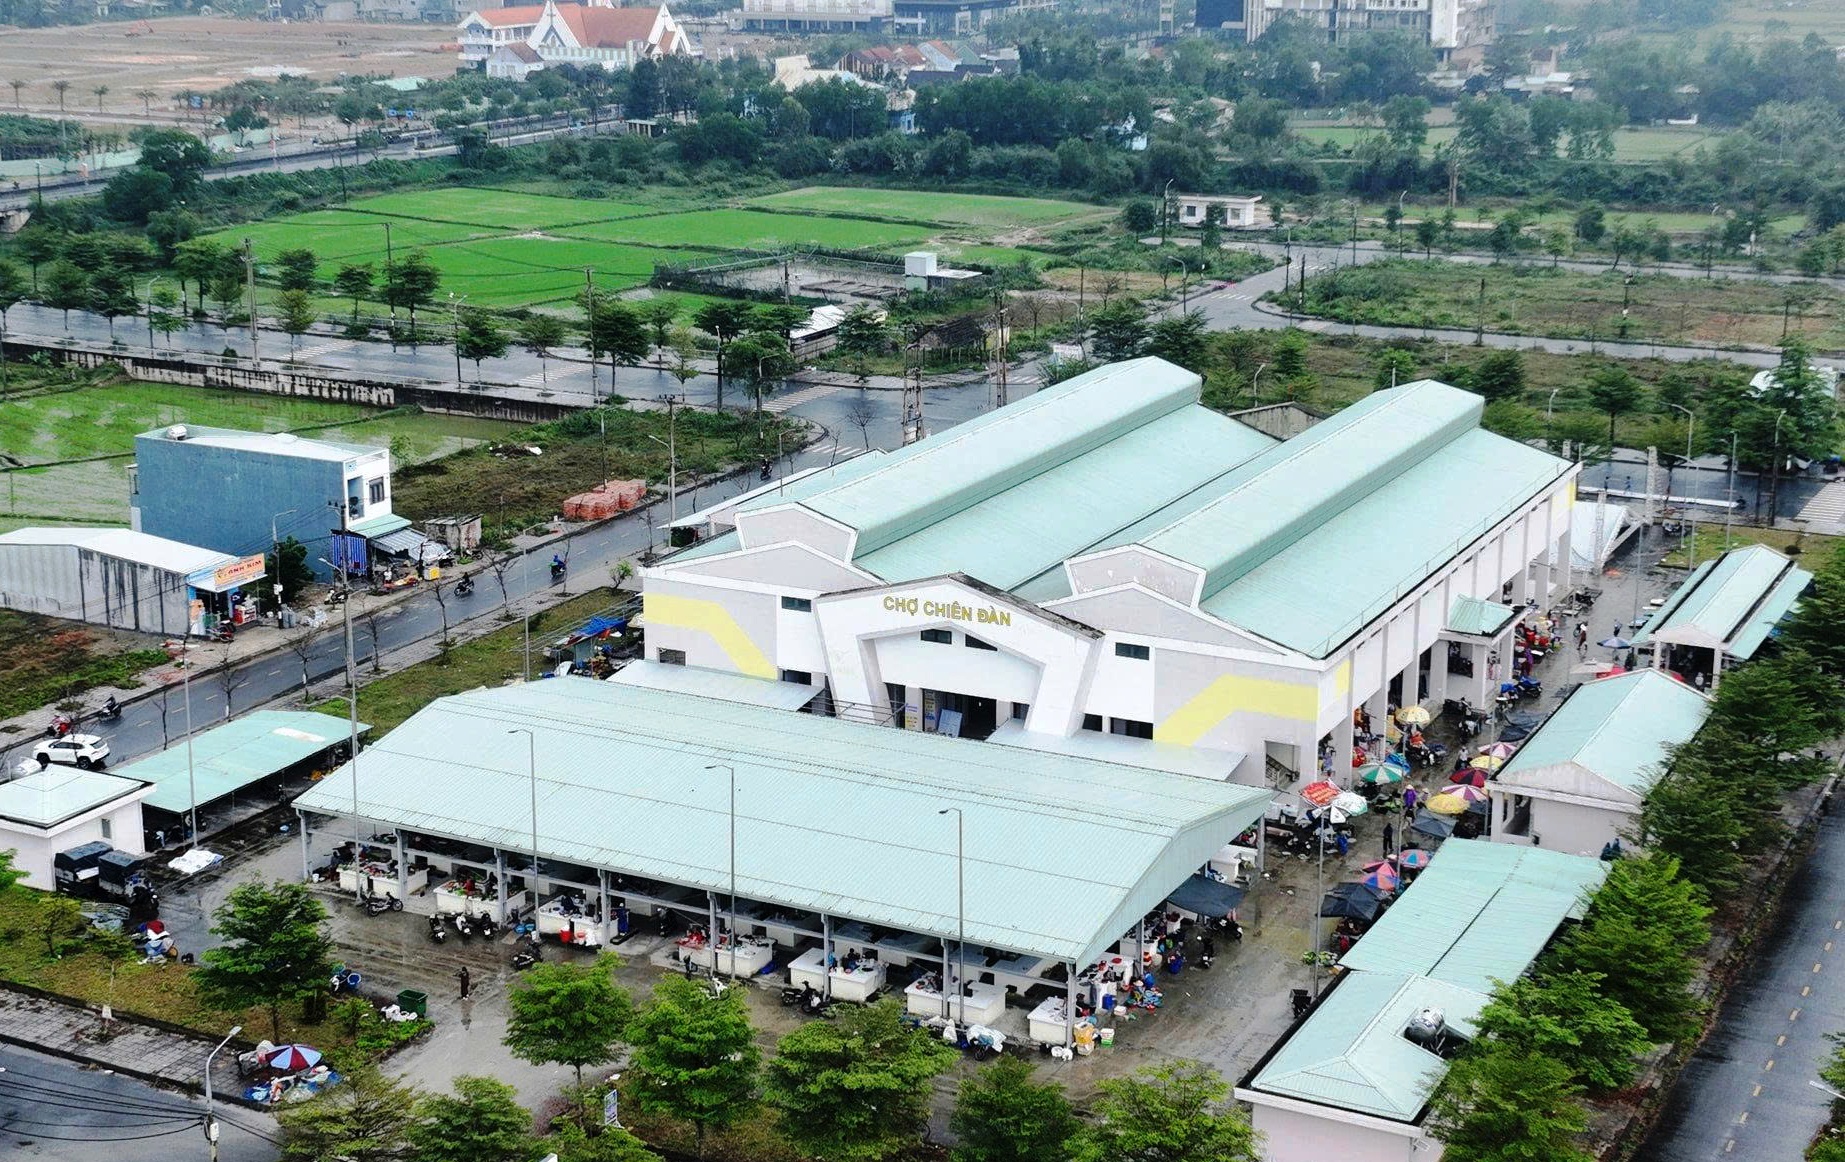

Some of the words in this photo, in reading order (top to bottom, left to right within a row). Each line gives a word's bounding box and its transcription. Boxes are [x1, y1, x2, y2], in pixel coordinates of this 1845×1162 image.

[883, 596, 919, 616] CHỢ
[923, 601, 973, 621] CHIÊN
[977, 605, 1011, 625] ĐÀN
